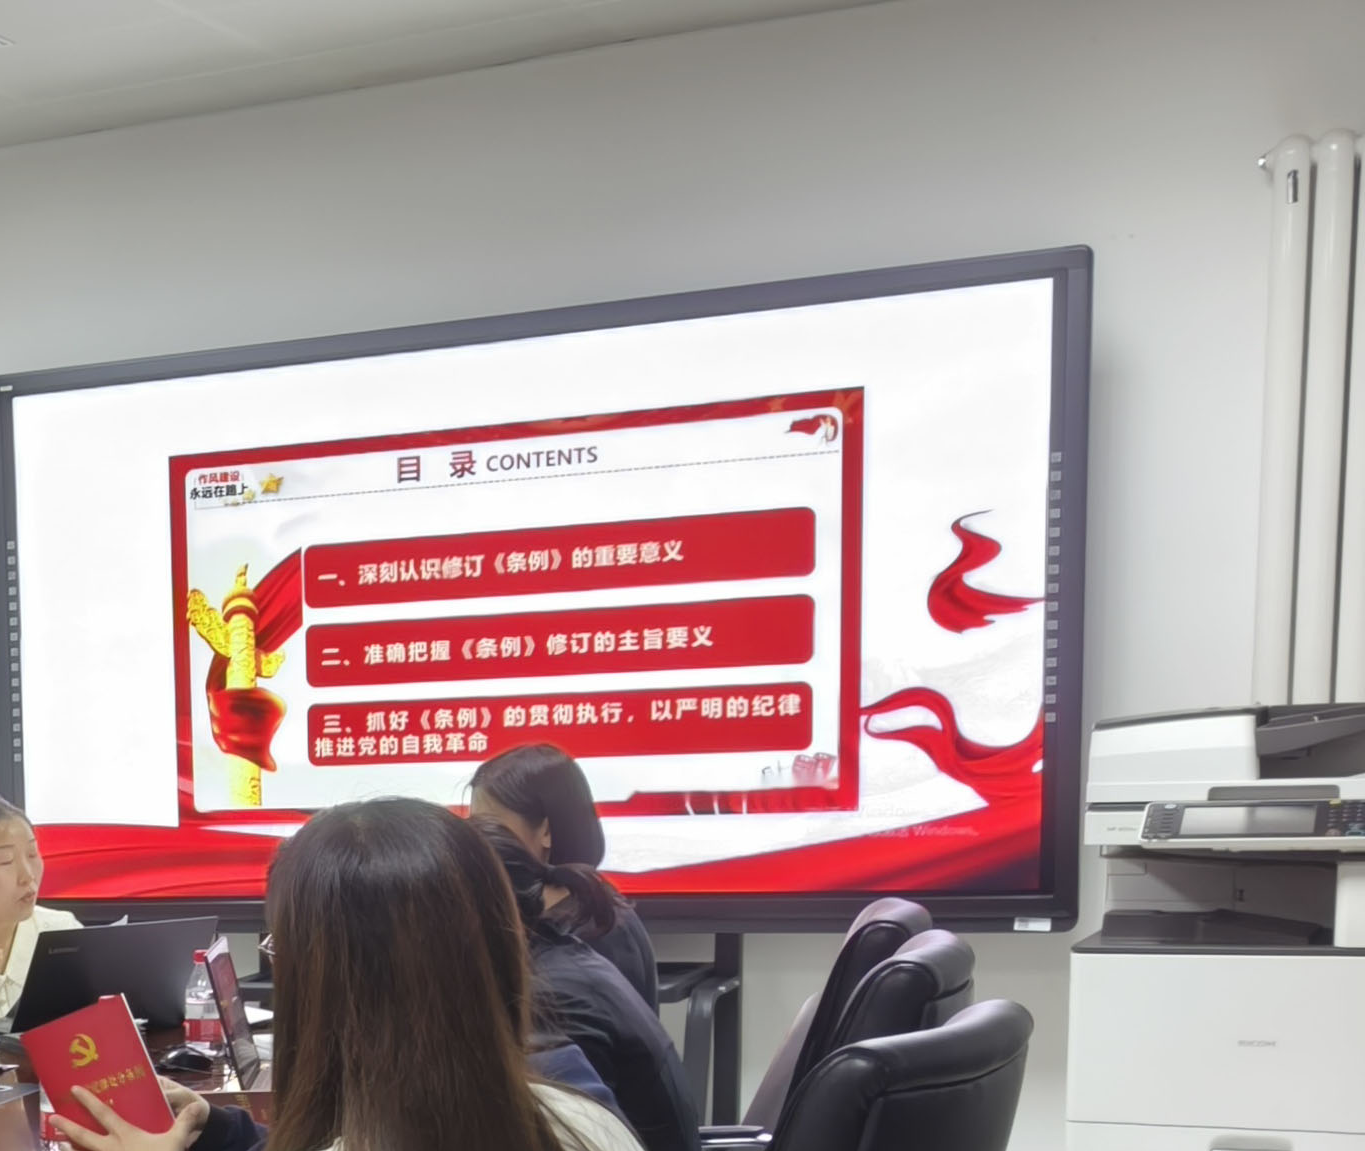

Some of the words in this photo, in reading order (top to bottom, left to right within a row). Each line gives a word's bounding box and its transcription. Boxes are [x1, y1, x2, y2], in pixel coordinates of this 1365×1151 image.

[486, 446, 599, 474] CONTENTS
[198, 470, 241, 484] 作风建设
[317, 541, 684, 587] 一、深刻认识修订《条例》的重要意义
[321, 624, 714, 667] 二、准确把握《条例》修订的主旨要义
[314, 731, 490, 758] 推进党的自我革命
